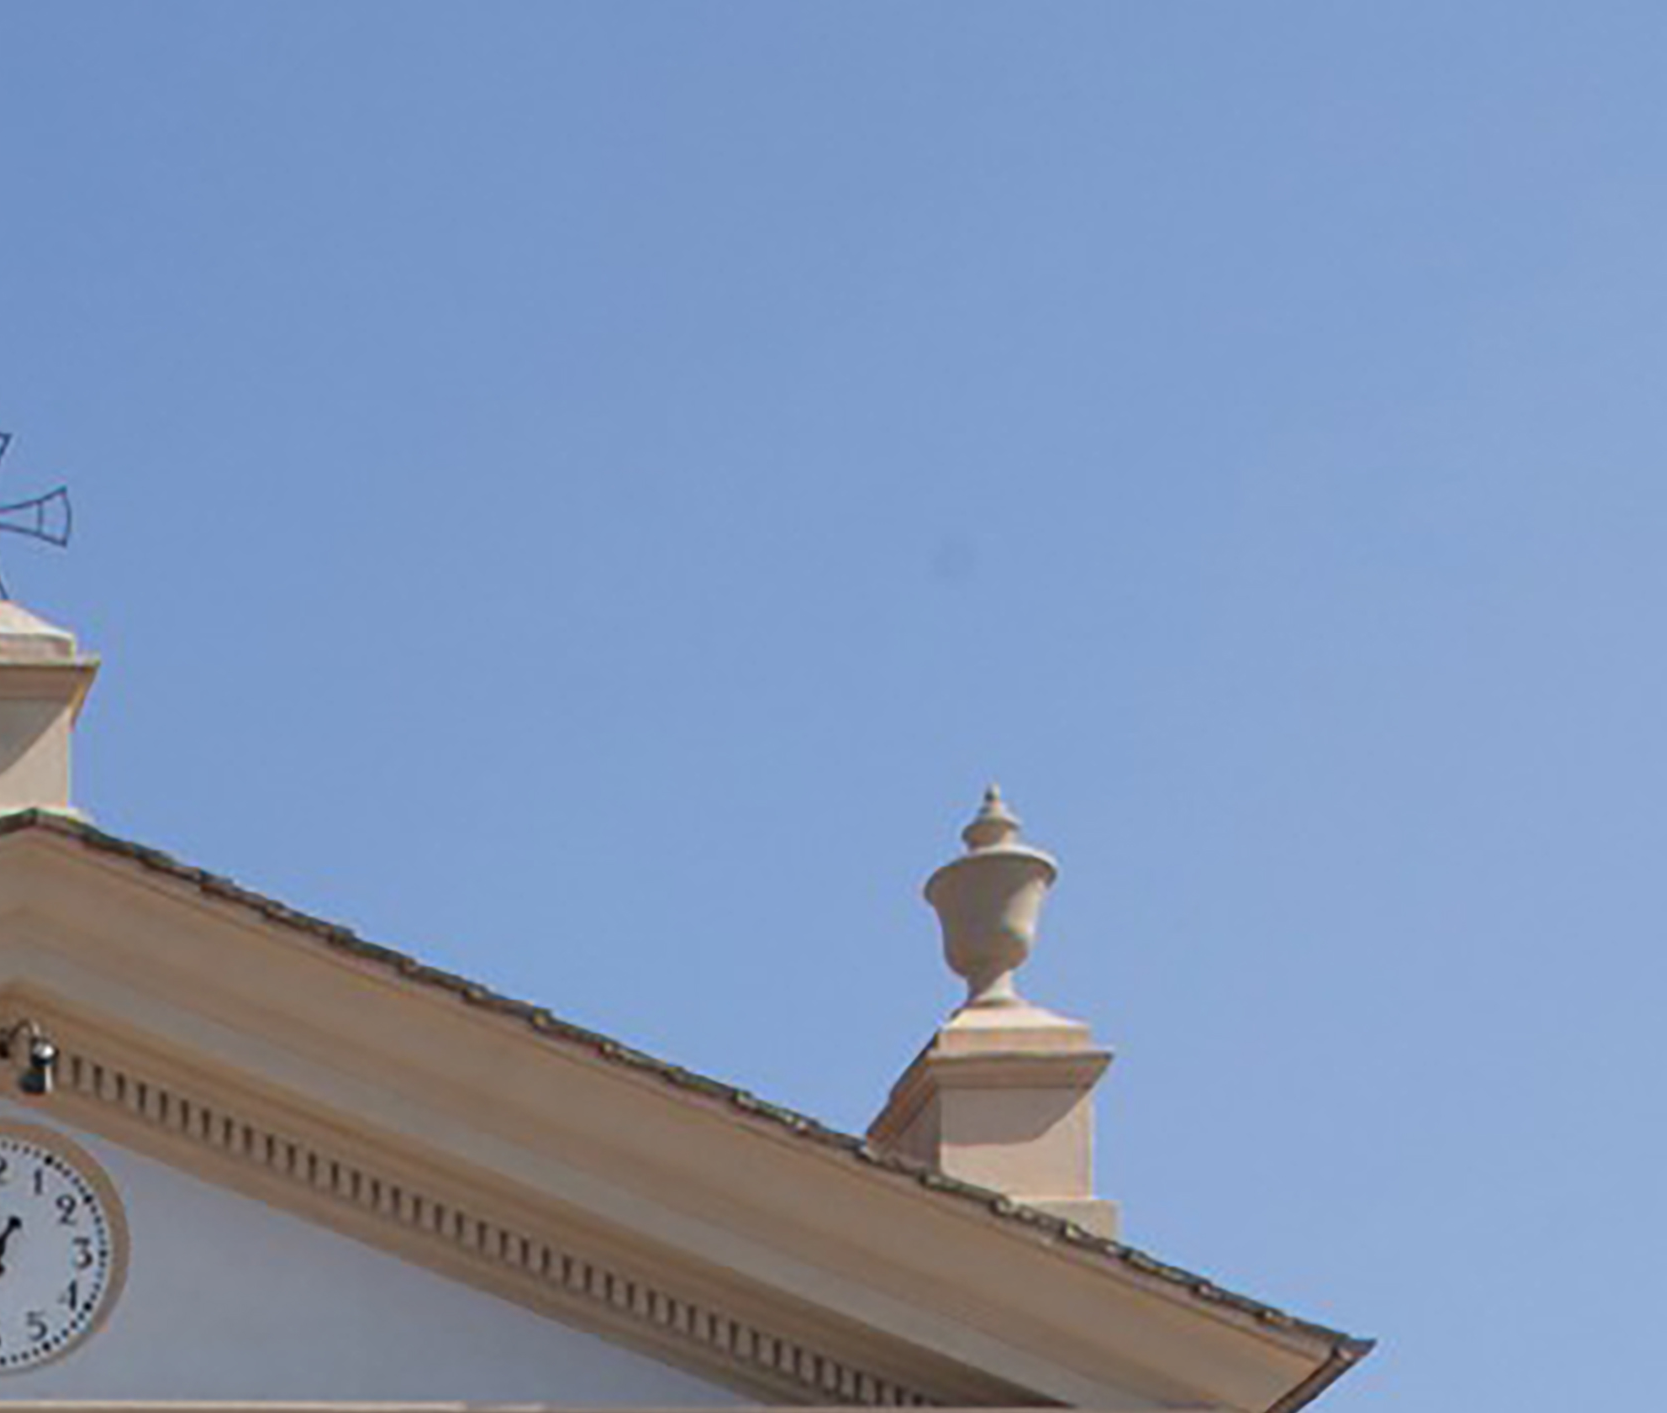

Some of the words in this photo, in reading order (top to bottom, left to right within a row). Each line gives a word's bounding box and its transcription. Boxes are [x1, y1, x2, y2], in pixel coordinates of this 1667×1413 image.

[34, 1168, 43, 1195] 1
[54, 1193, 78, 1226] 2
[72, 1236, 94, 1270] 3
[56, 1279, 78, 1311] 4
[26, 1311, 48, 1342] 5
